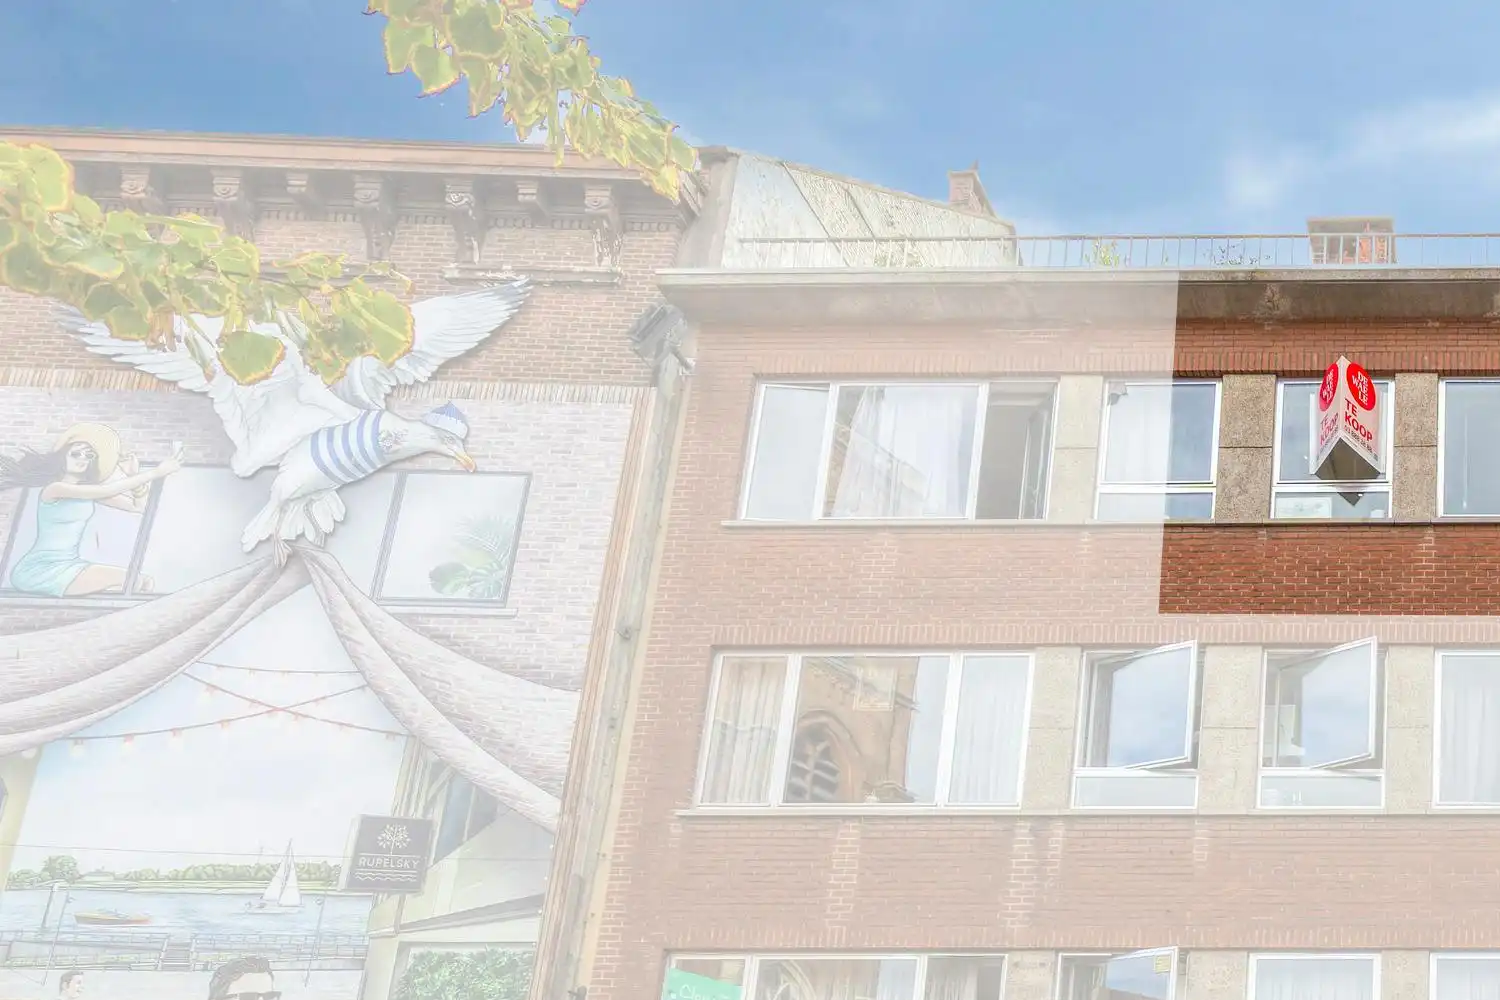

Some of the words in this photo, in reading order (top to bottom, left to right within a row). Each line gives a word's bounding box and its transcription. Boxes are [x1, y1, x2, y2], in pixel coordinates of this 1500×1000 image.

[1345, 397, 1357, 417] TE
[1344, 411, 1373, 441] KOOP
[358, 857, 420, 869] RUPELSKY
